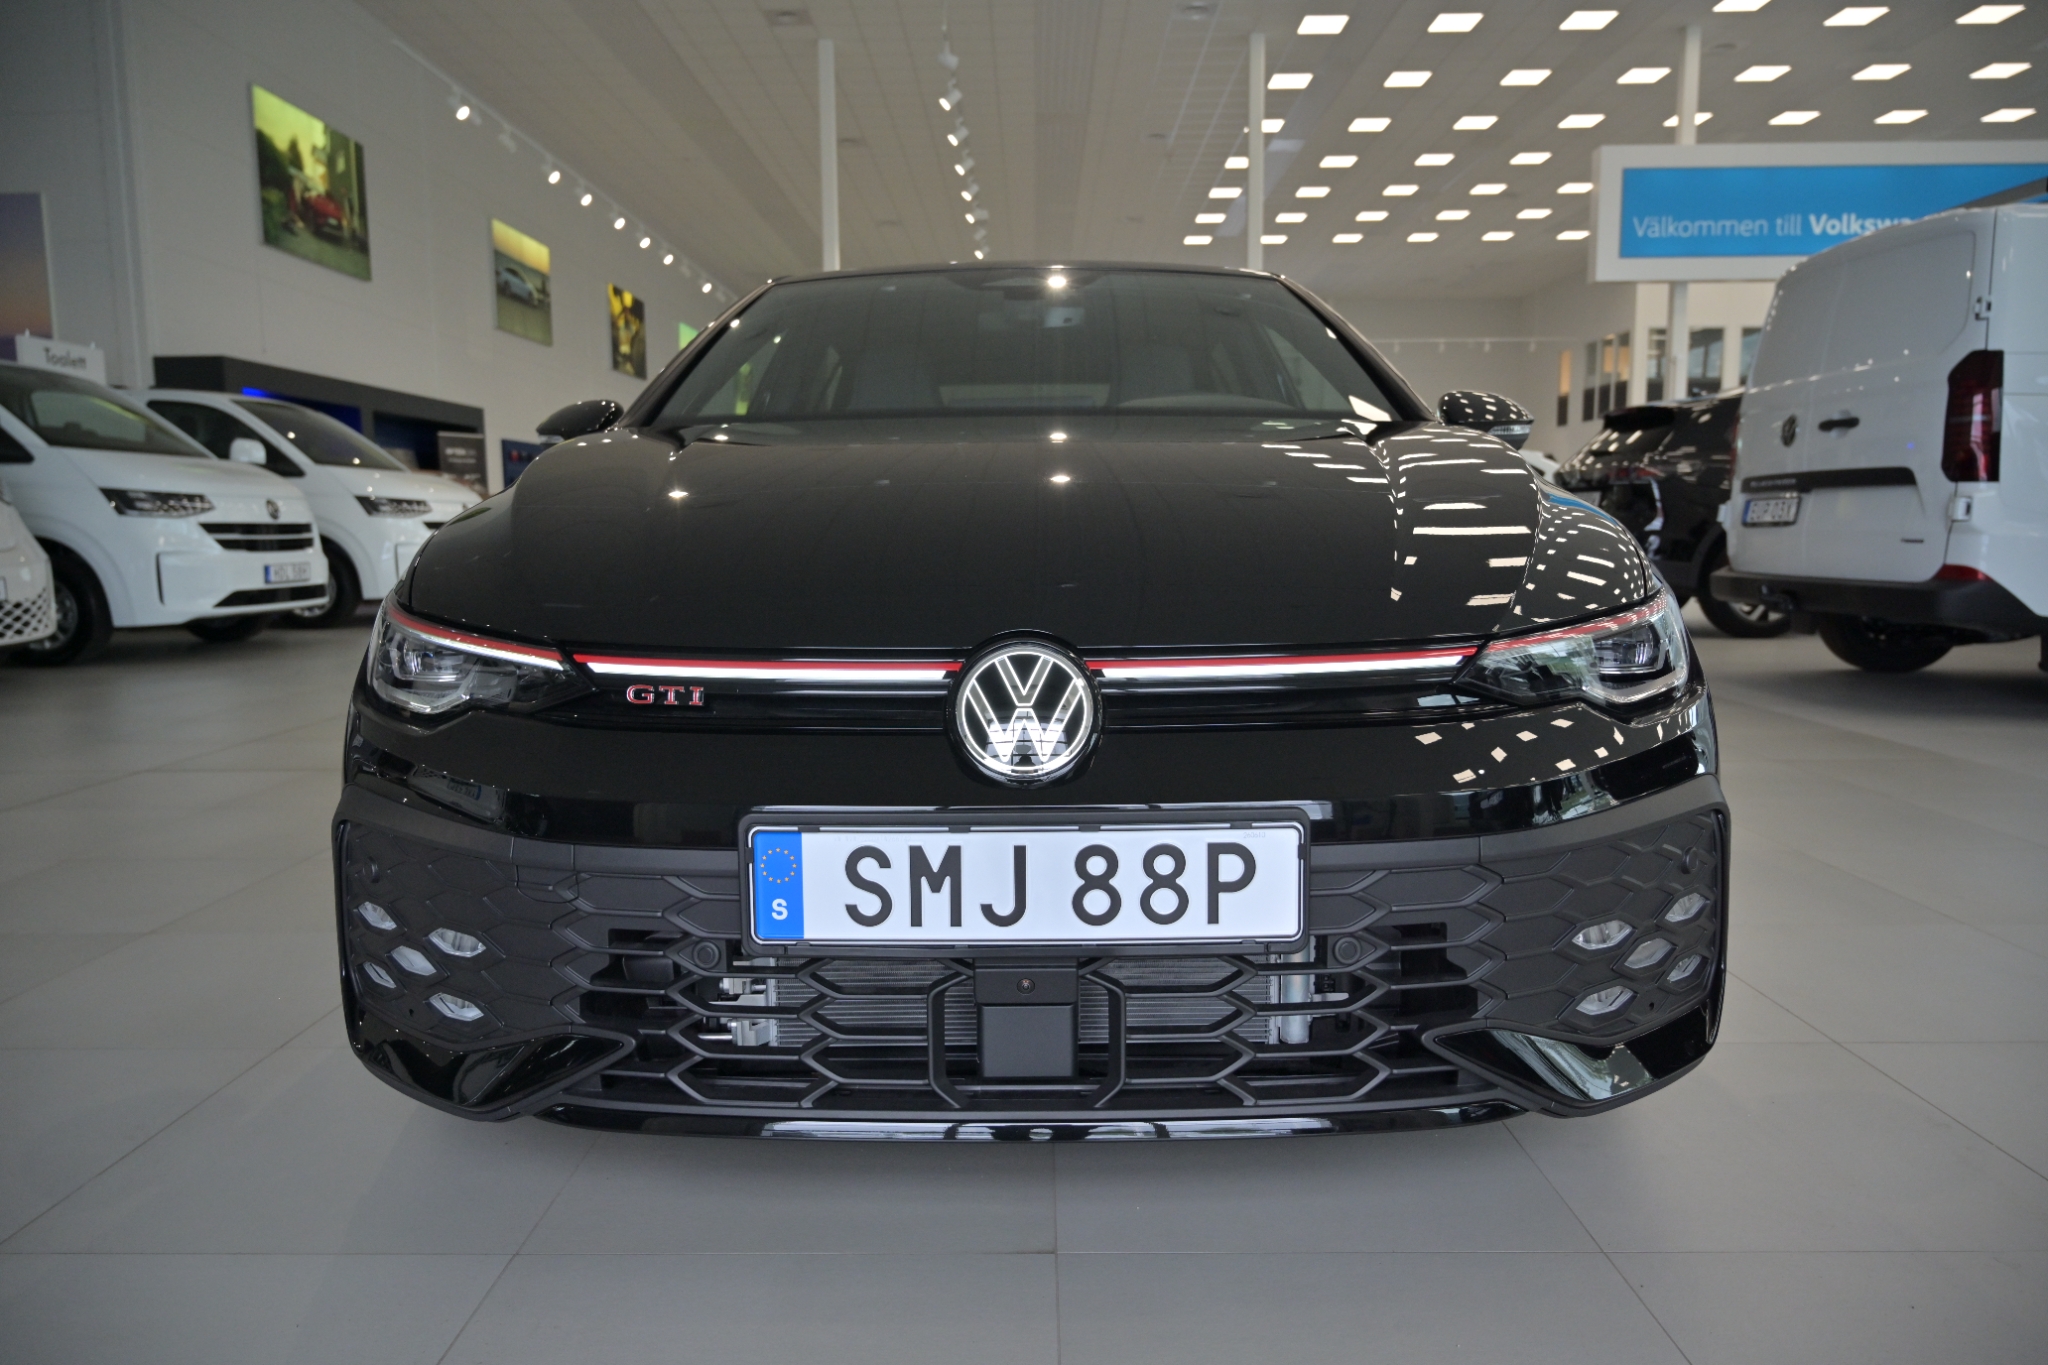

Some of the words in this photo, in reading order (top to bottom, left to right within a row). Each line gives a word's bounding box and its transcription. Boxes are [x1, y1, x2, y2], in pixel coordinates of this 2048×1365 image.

[1632, 214, 1769, 238] Välkommen
[1775, 213, 1802, 236] till
[626, 684, 704, 706] GTI
[845, 844, 1027, 928] SMJ
[1071, 842, 1257, 926] 88P
[771, 898, 789, 921] S
